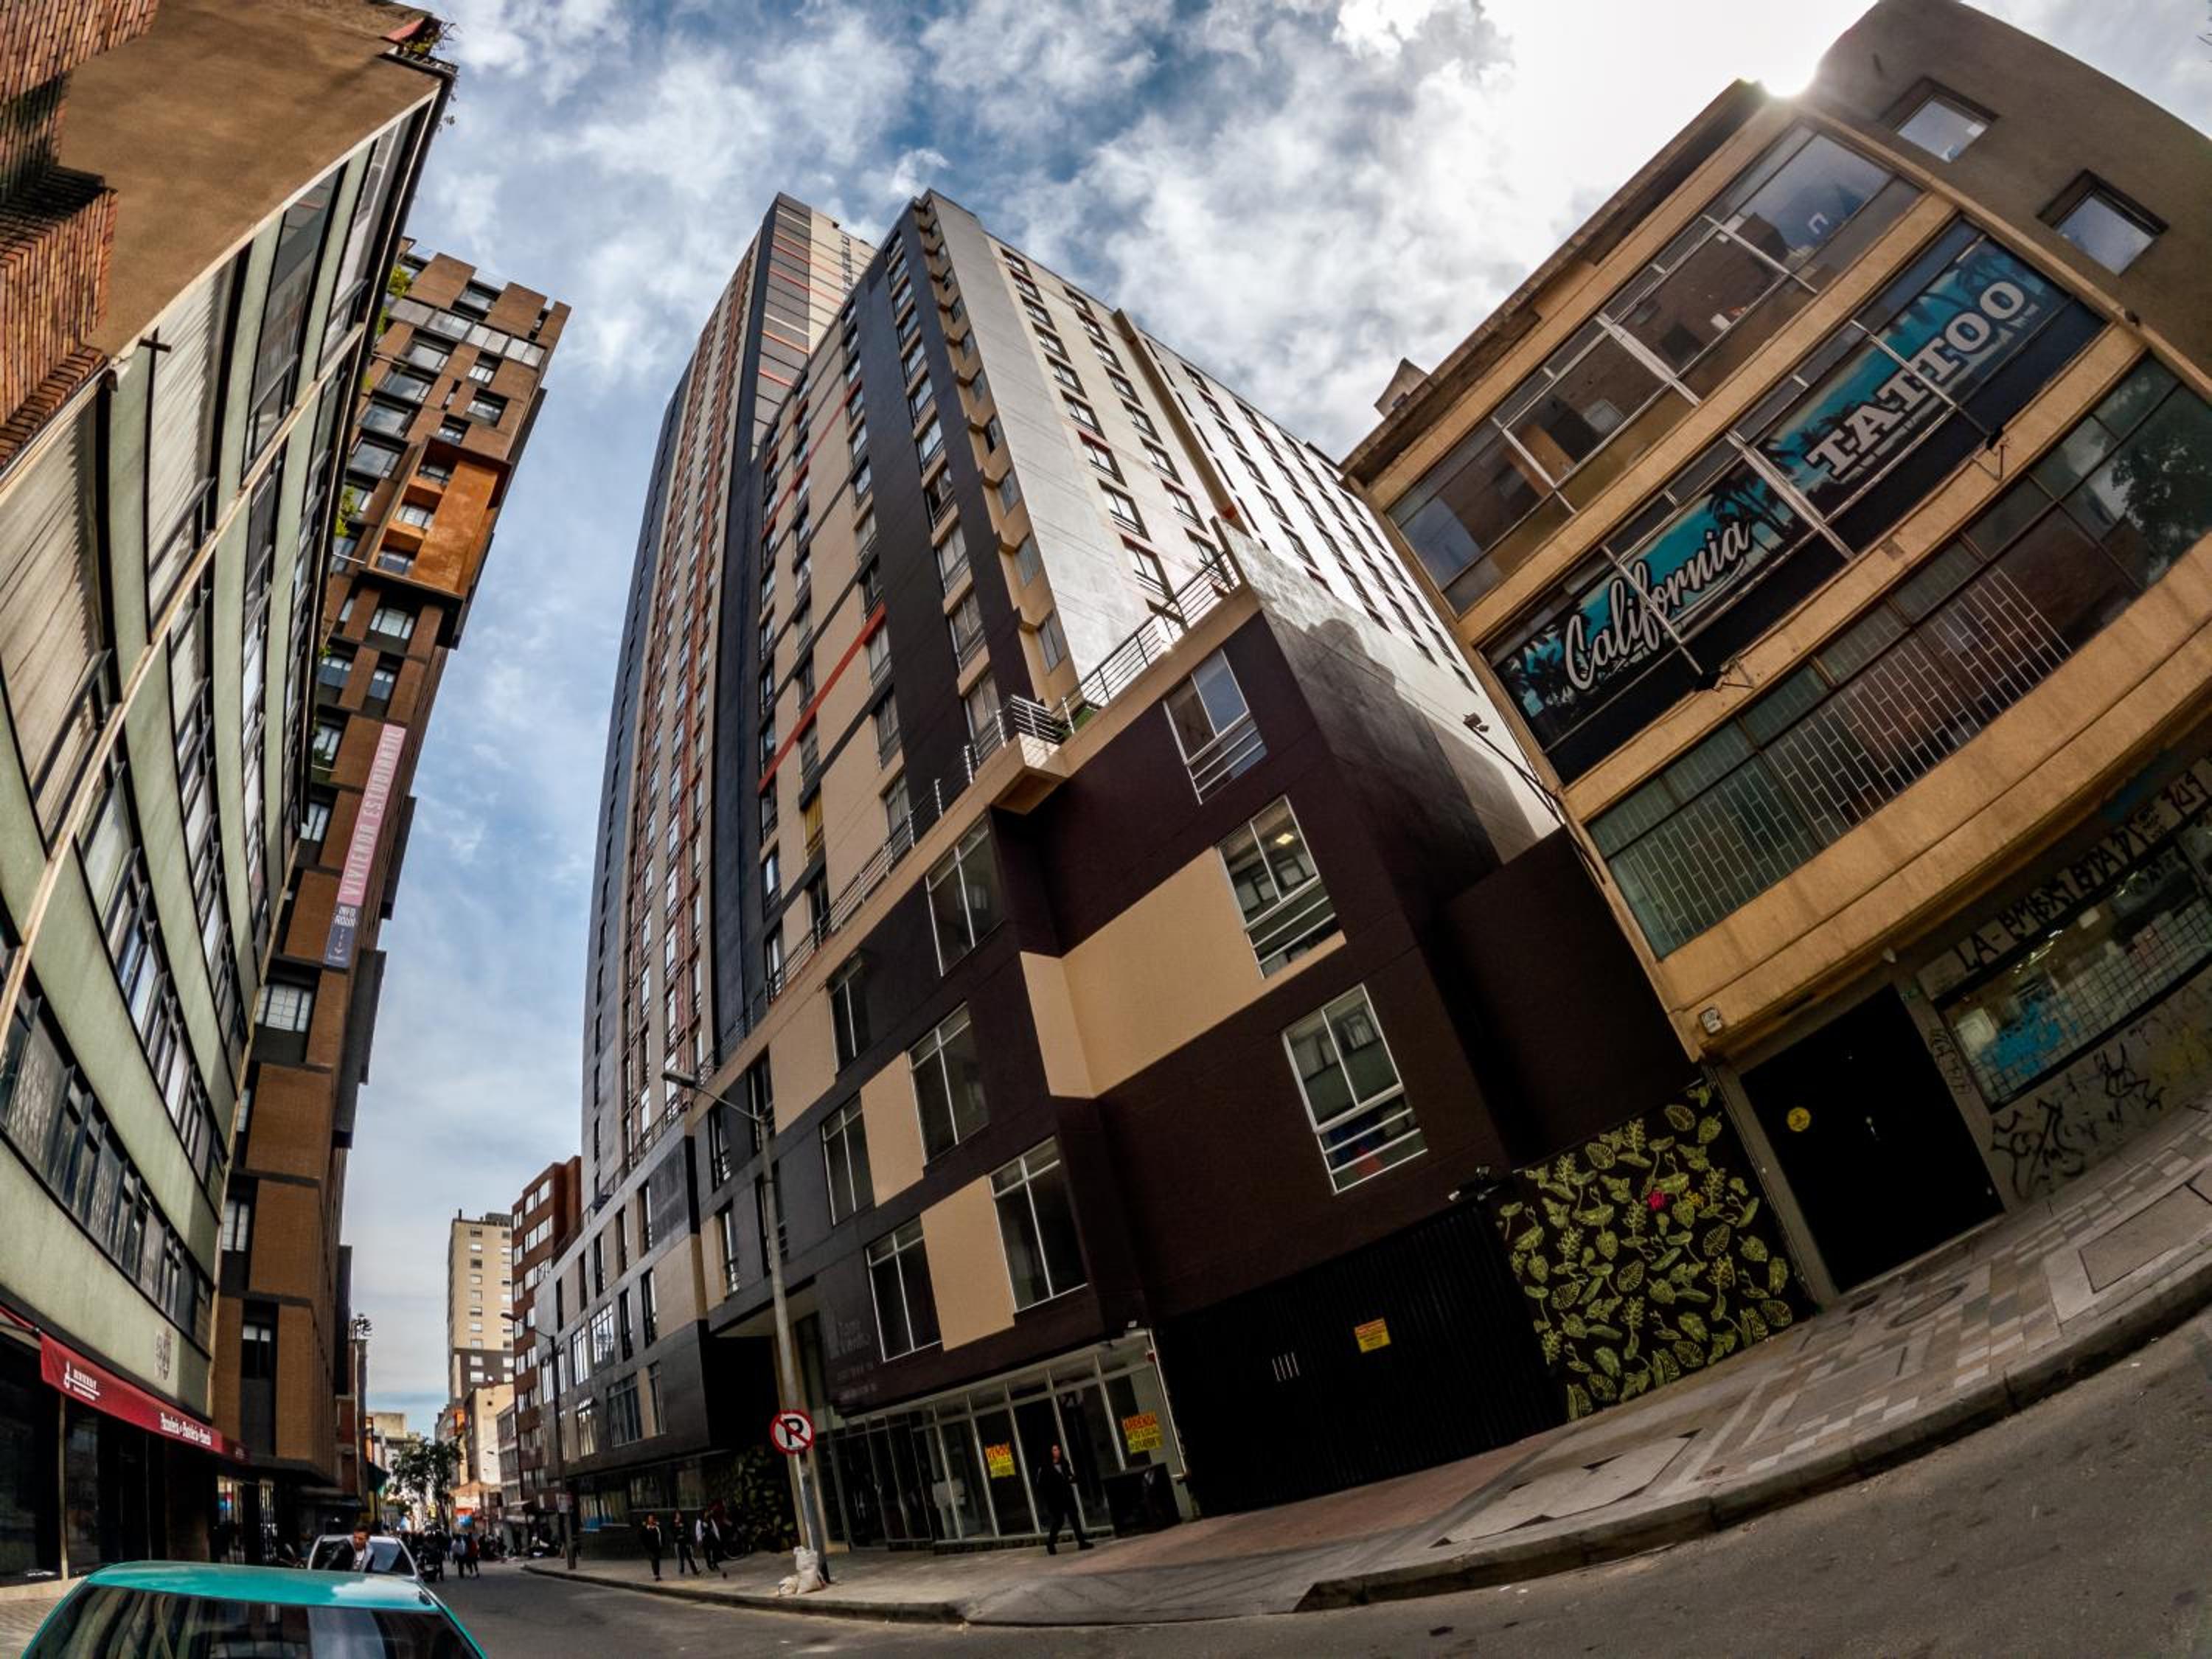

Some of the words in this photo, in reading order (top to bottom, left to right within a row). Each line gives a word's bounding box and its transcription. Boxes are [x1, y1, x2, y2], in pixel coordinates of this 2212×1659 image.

[1565, 521, 1752, 691] California
[1806, 281, 2025, 477] TATTOO
[783, 1418, 804, 1446] P
